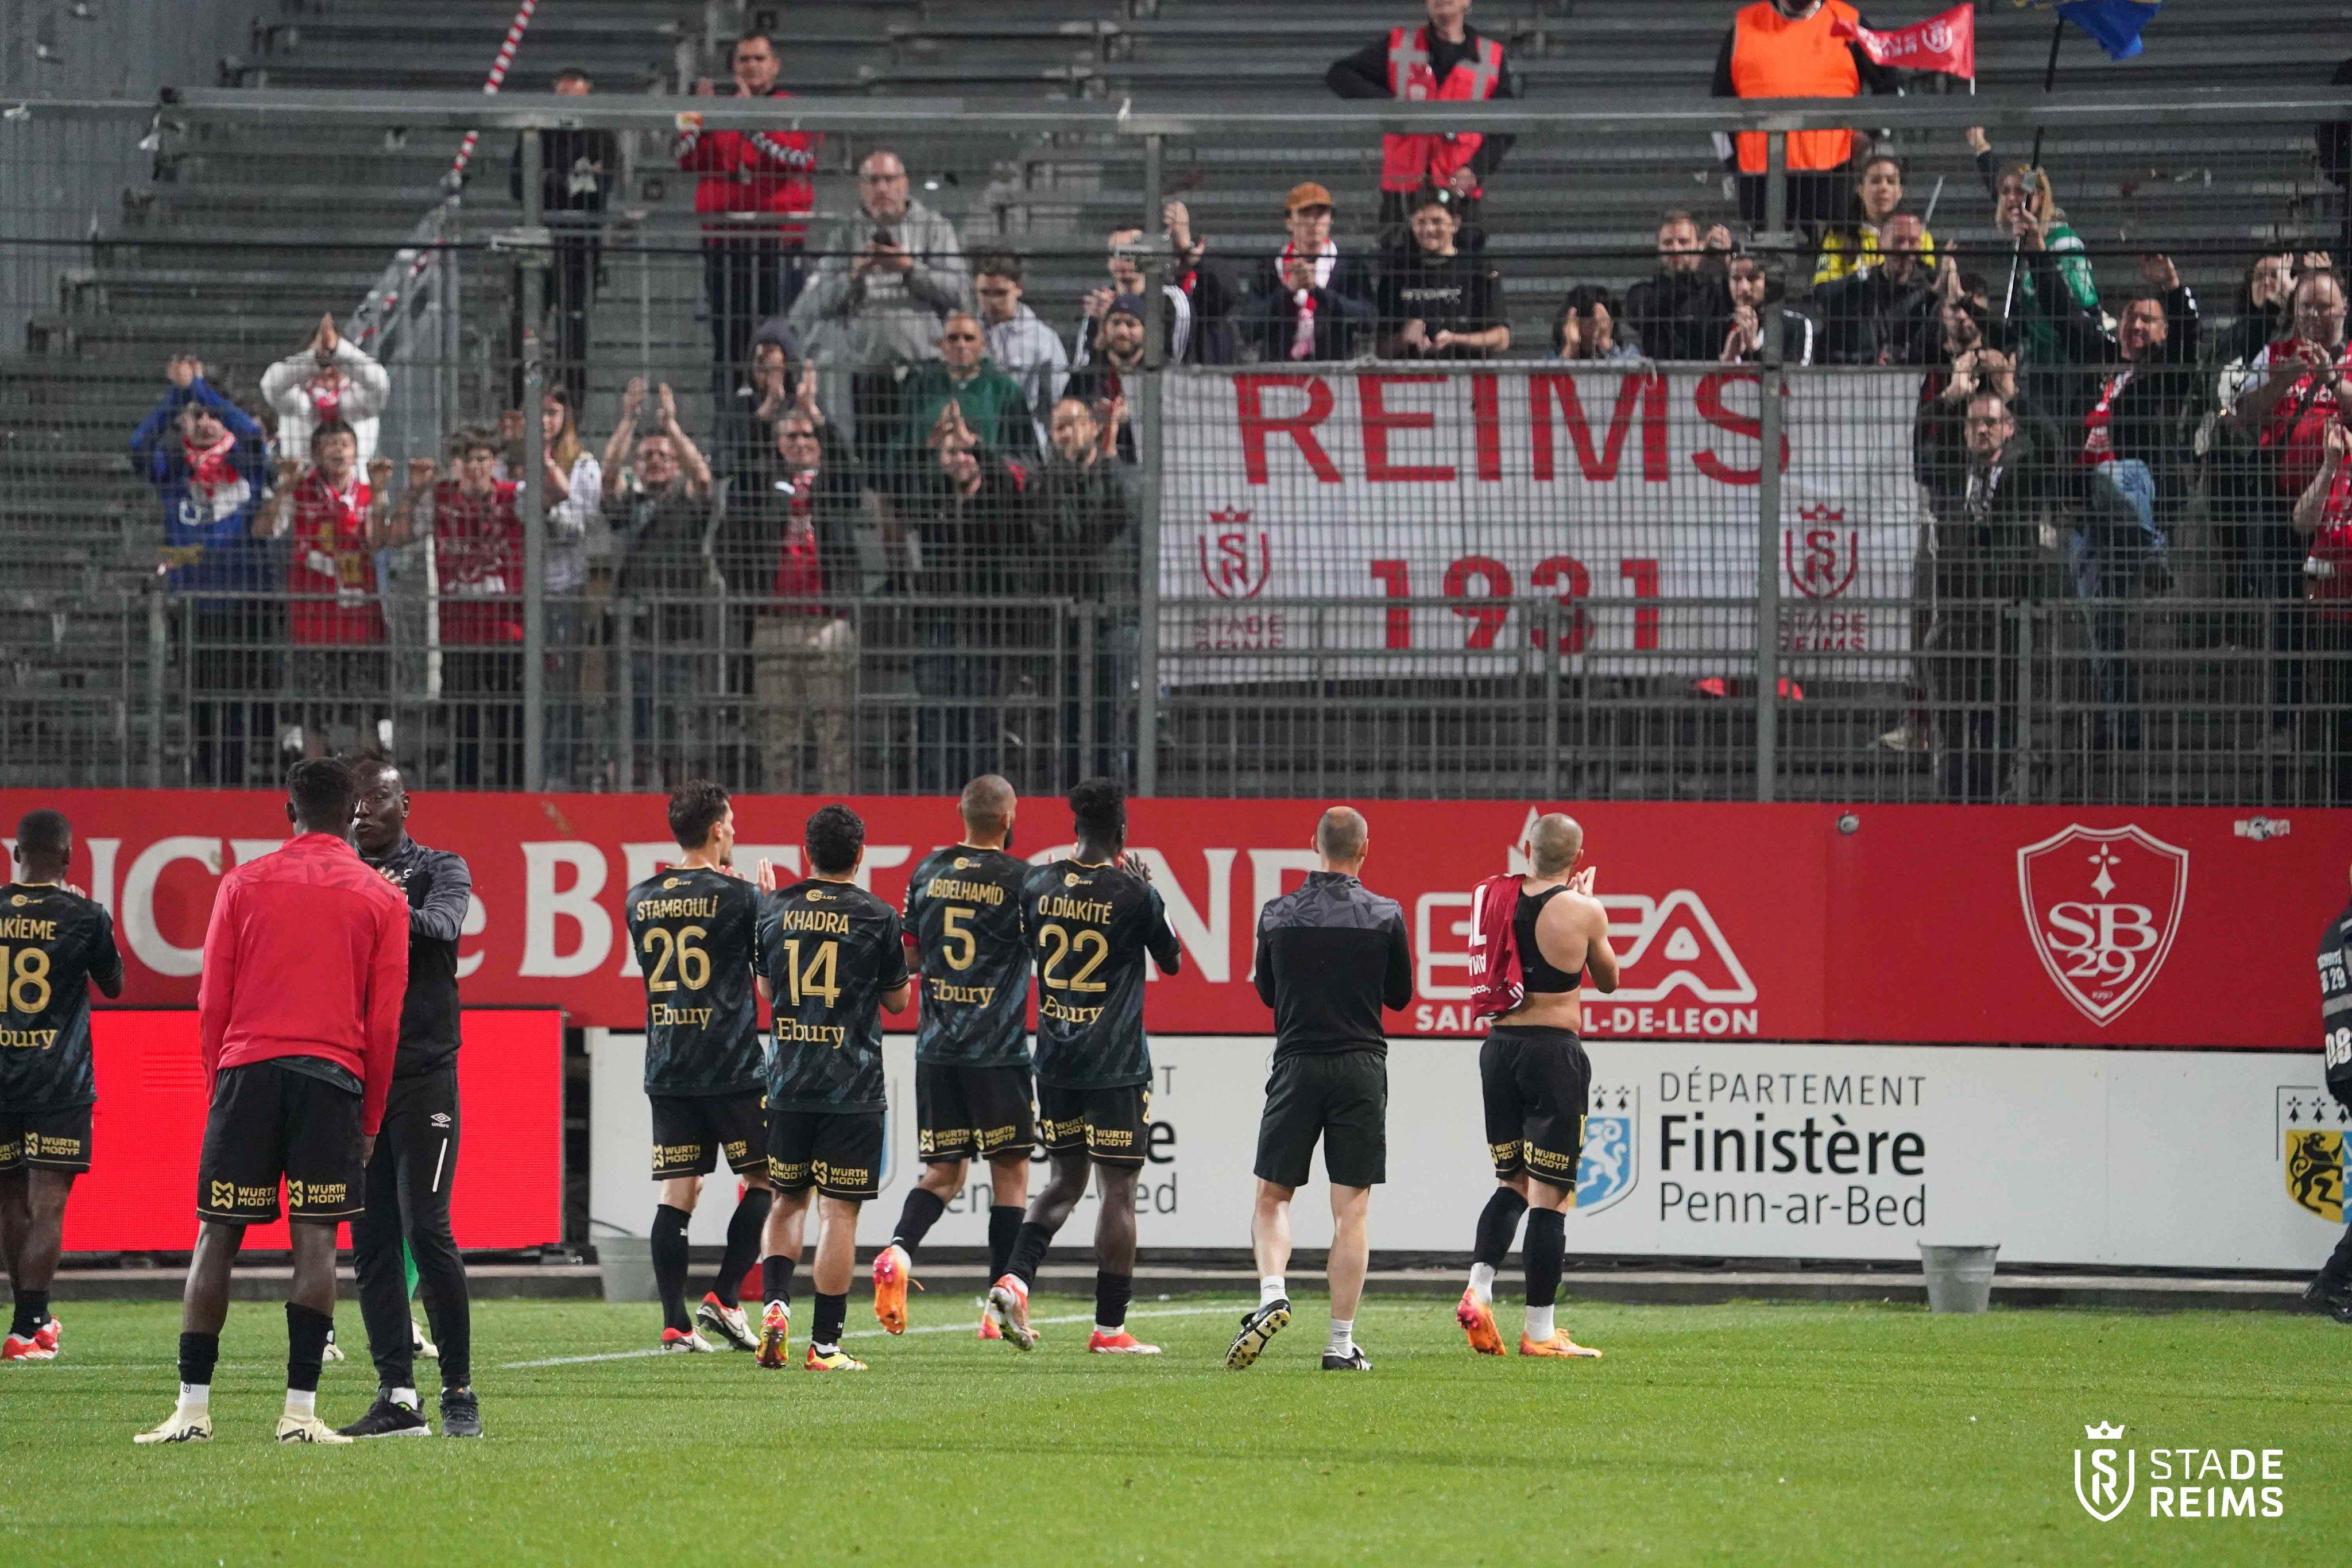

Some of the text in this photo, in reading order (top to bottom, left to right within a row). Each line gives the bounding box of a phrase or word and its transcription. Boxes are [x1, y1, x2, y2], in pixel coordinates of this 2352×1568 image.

[1232, 372, 1790, 485] REIMS
[1370, 555, 1659, 656] 1931
[783, 910, 849, 935] KHADRA
[943, 906, 976, 970] 5
[643, 925, 711, 992] 26
[783, 939, 842, 1009] 14
[1039, 924, 1108, 992] 22
[2067, 948, 2136, 987] 29
[0, 945, 52, 1013] 18
[651, 1003, 713, 1031] Ebury
[1040, 994, 1105, 1025] Ebury
[0, 1024, 58, 1050] bury
[776, 1017, 845, 1050] Ebury
[1660, 1066, 1927, 1106] DÉPARTEMENT
[1096, 1137, 1133, 1147] MODYF
[1661, 1112, 1927, 1175] Finistère
[307, 1194, 346, 1204] MODYF
[830, 1176, 868, 1186] MODYF
[1661, 1182, 1926, 1226] Penn-ar-Bed
